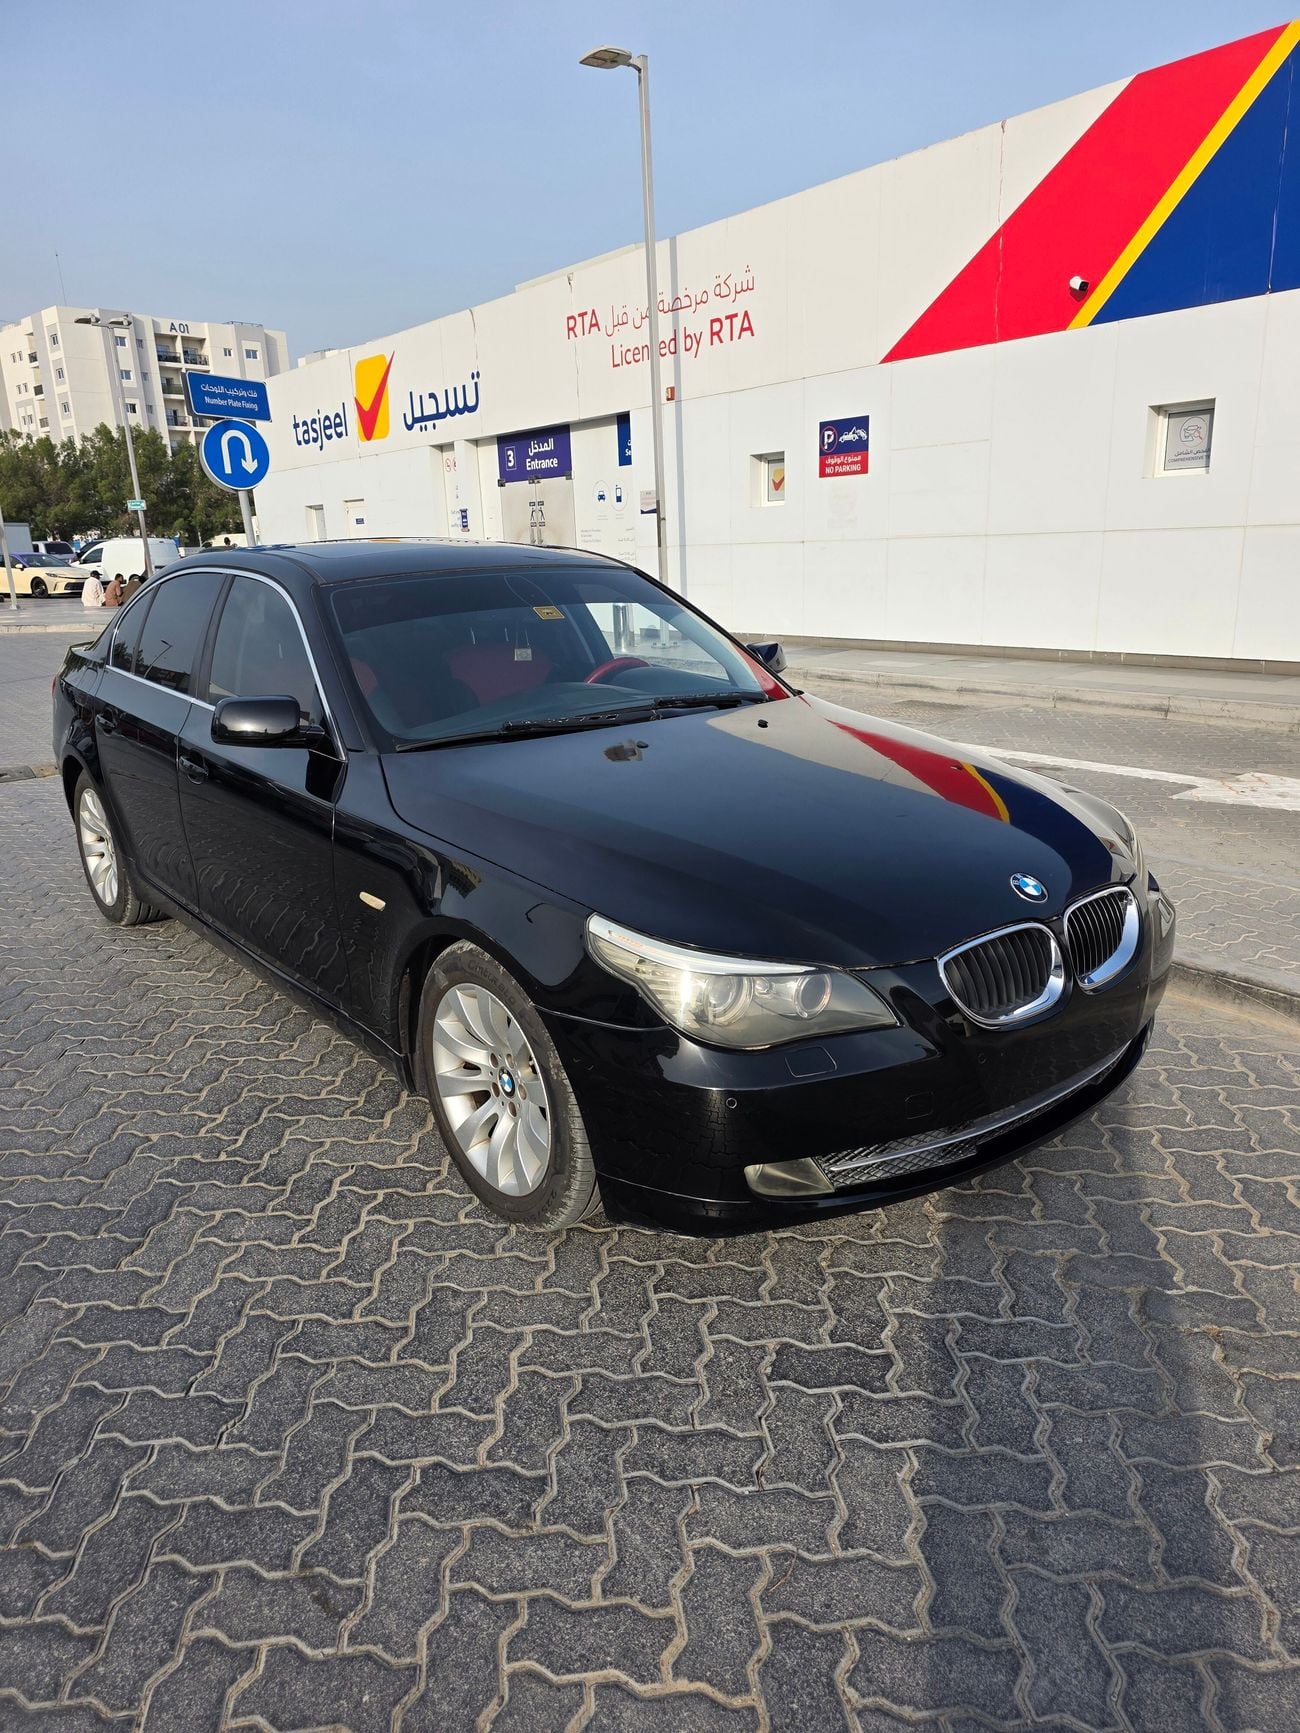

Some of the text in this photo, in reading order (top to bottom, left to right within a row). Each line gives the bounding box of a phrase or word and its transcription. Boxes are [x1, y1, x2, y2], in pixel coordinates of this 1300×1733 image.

[713, 265, 755, 304] شركة
[657, 287, 709, 314] مرخصة
[566, 308, 601, 340] RTA
[605, 304, 629, 337] قبل
[611, 309, 755, 368] Licened by RTA
[200, 383, 258, 398] فك وتركيب اللوحات
[403, 371, 481, 433] تسجيل
[204, 396, 258, 411] Number Plate Fixing
[293, 402, 349, 451] tasjeel
[528, 437, 554, 456] المدخل
[506, 450, 515, 467] 3
[525, 457, 558, 471] Entrance
[825, 455, 861, 465] ممنوع الوقوف
[825, 464, 861, 475] NO PARKING
